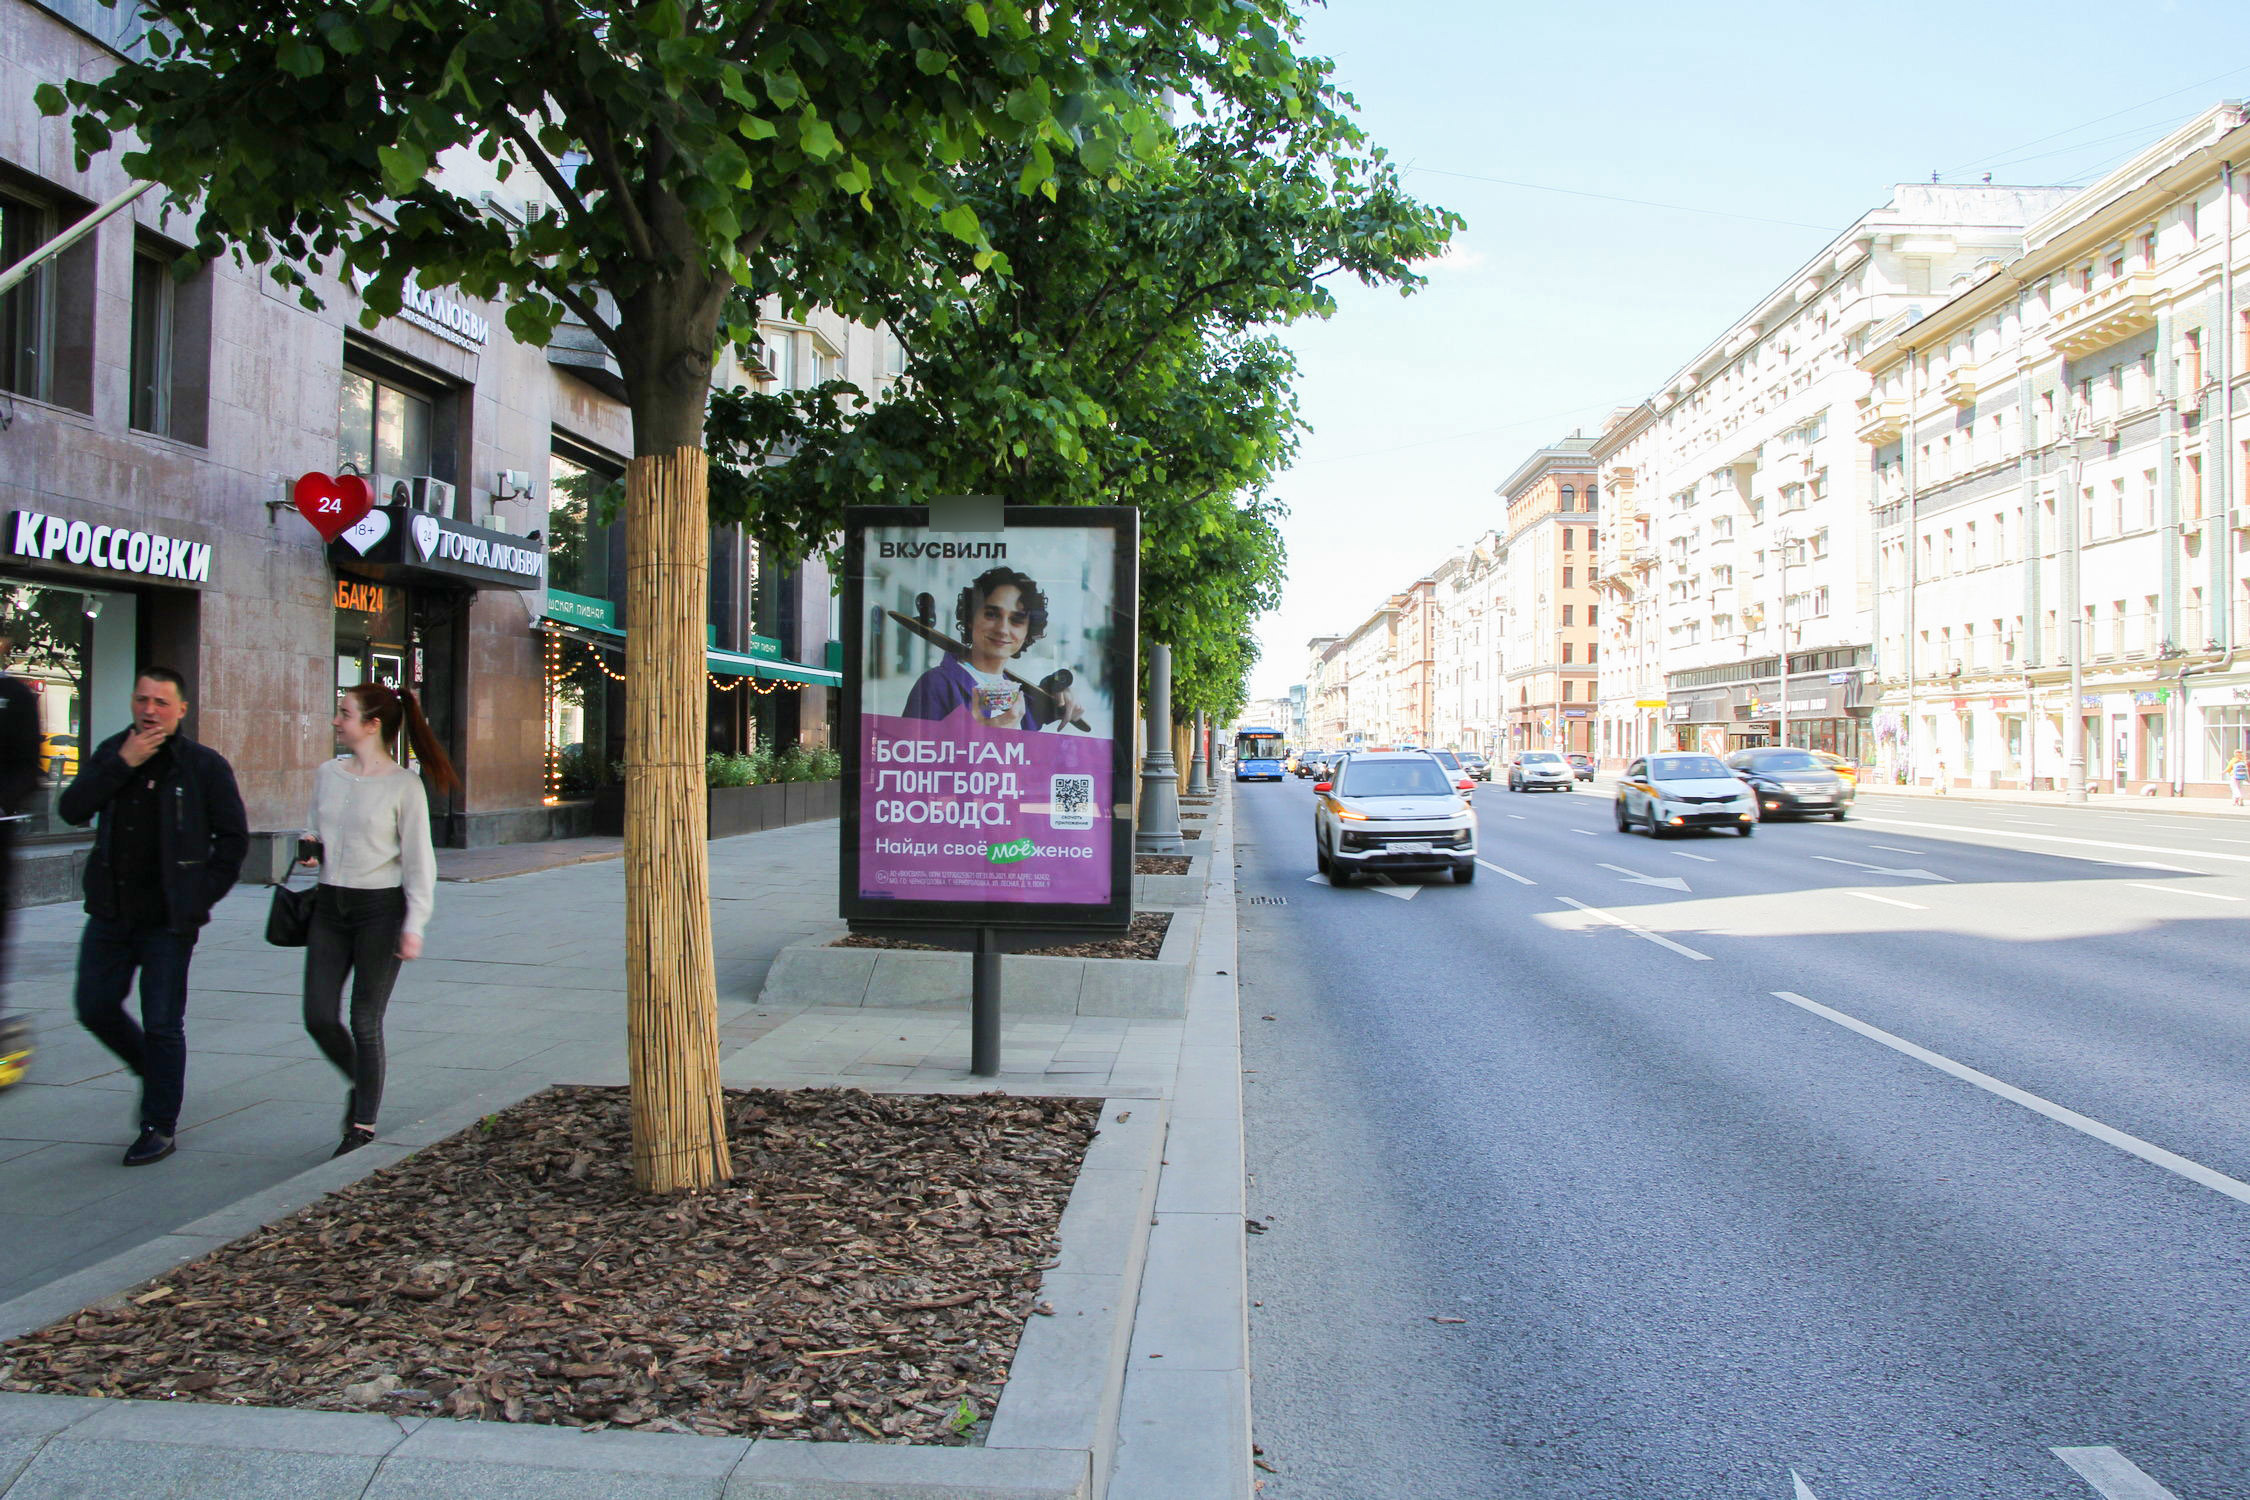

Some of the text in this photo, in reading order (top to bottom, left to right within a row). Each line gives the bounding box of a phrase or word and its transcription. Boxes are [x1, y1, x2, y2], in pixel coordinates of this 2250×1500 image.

[318, 496, 342, 513] 24
[354, 523, 376, 536] 18+
[14, 510, 212, 583] КРОССОВКИ
[879, 541, 1007, 559] ВКУСВИЛЛ
[875, 769, 1025, 800] ЛОНГБОРД.
[875, 838, 938, 857] Найди
[943, 840, 988, 856] своё
